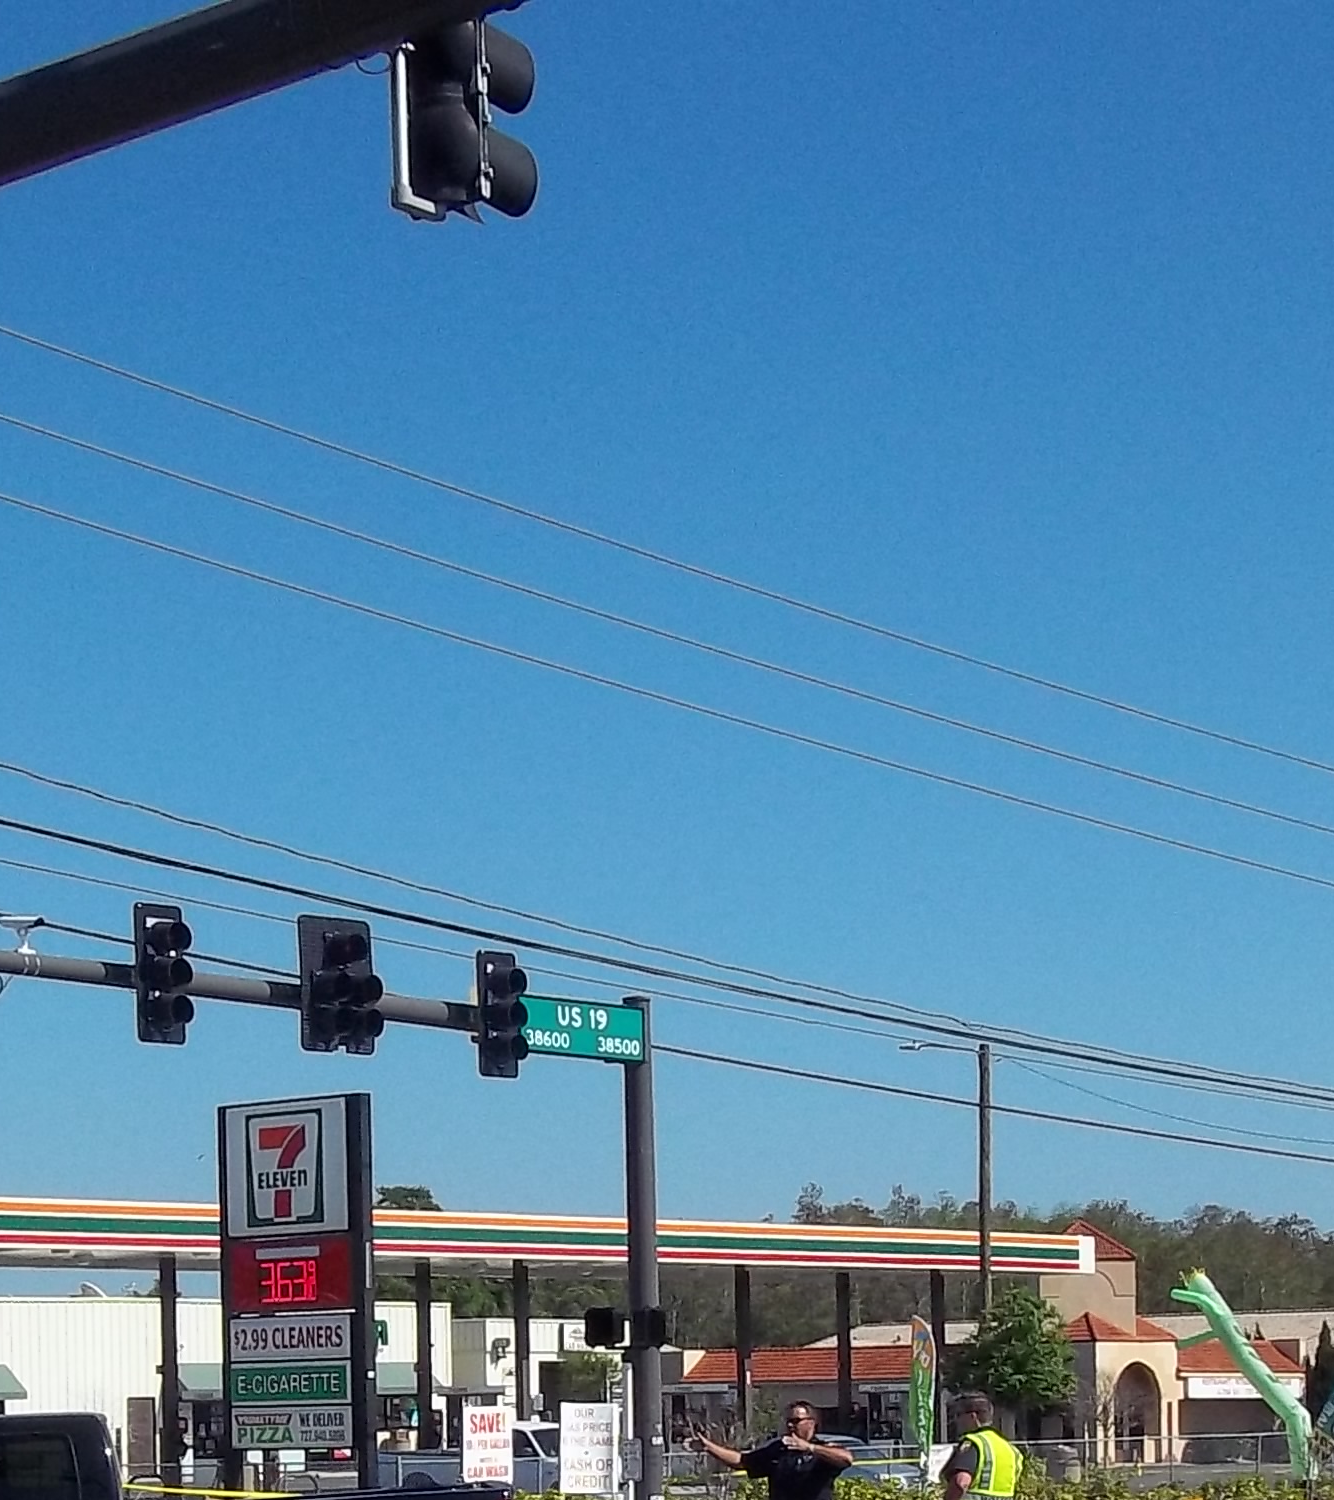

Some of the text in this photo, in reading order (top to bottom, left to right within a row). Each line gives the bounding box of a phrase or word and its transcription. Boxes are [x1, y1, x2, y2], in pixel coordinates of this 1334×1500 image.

[557, 1004, 608, 1030] US 19
[526, 1028, 641, 1056] 38600 38500
[258, 1123, 307, 1218] 7
[234, 1324, 343, 1351] $2.99 CLEANERS
[237, 1373, 340, 1395] E-CIGARETTE
[469, 1412, 506, 1434] SAVE!
[574, 1408, 595, 1419] OUR
[237, 1427, 294, 1443] PIZZA
[582, 1422, 611, 1433] PRICE
[596, 1458, 613, 1471] OR
[568, 1474, 611, 1489] CREDIT
